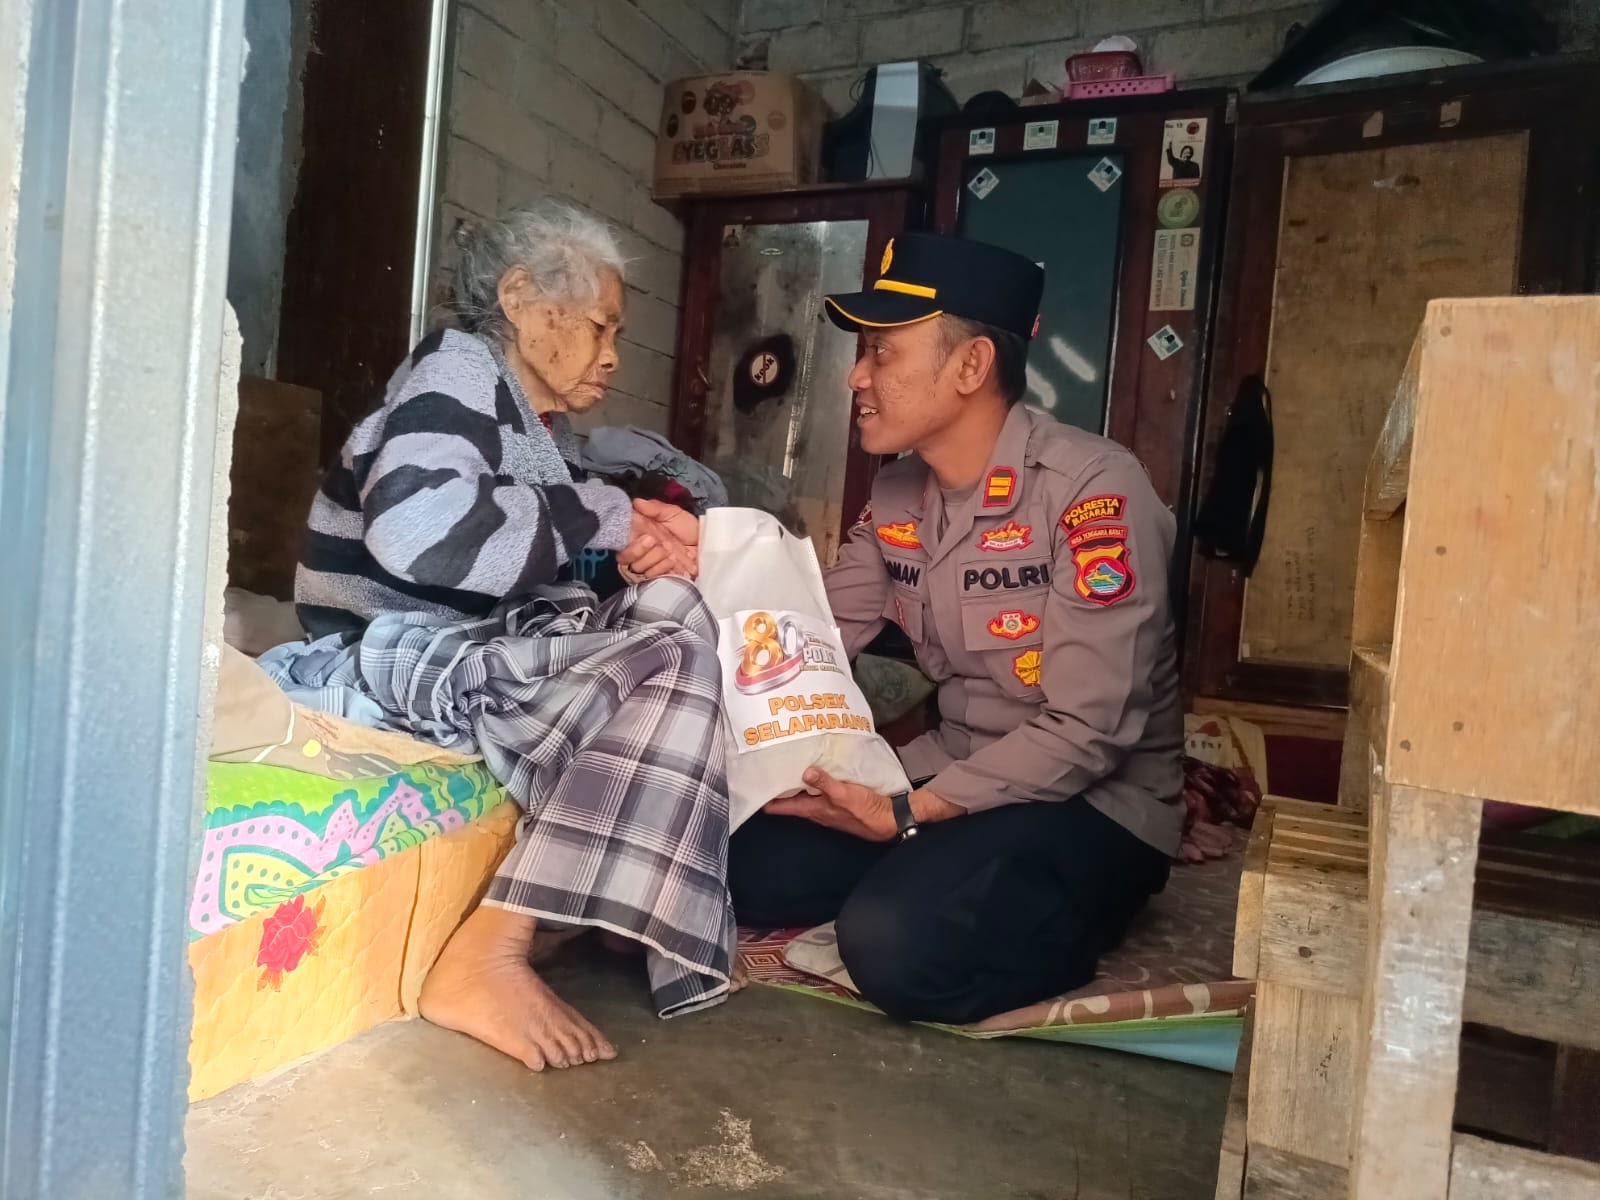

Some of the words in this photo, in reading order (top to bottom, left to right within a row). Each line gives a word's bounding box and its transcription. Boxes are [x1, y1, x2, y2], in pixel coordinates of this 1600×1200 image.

[1064, 498, 1119, 524] POLRESTA
[963, 564, 1049, 591] POLRI
[803, 647, 837, 664] POL
[768, 693, 848, 714] POLSEK
[745, 714, 871, 745] SELAPARANG
